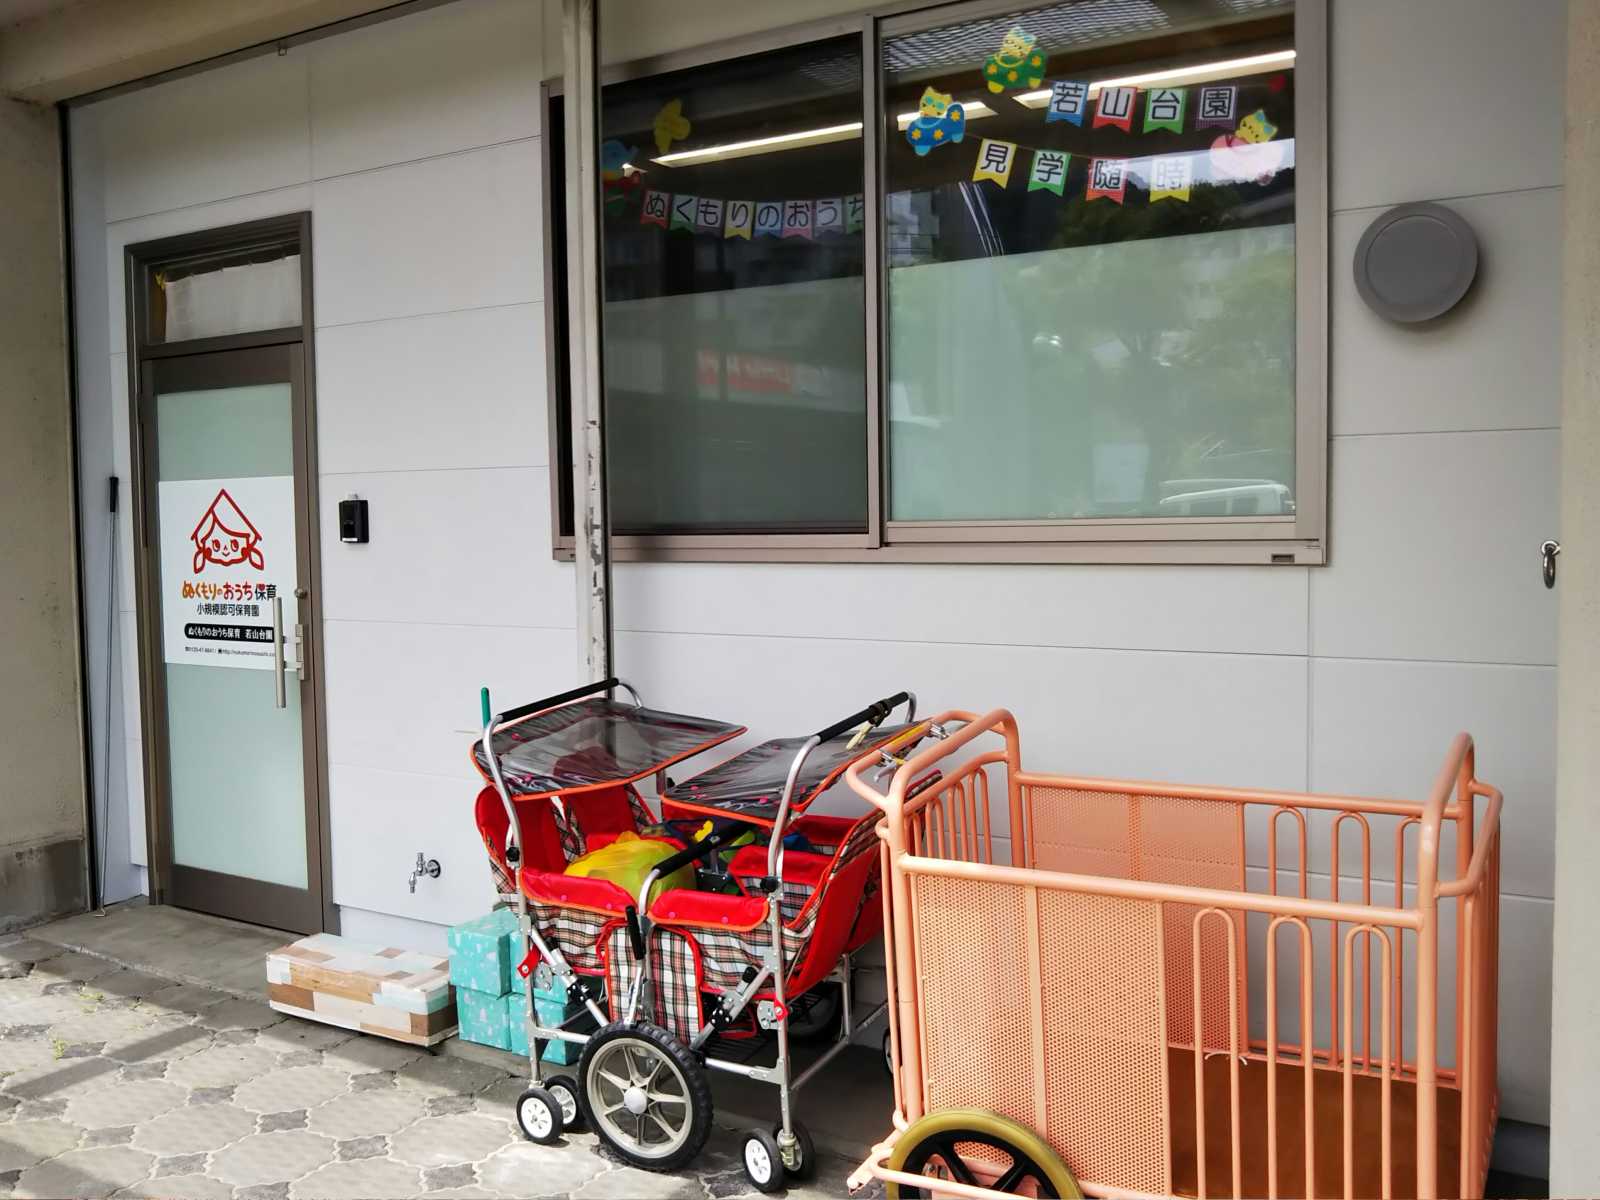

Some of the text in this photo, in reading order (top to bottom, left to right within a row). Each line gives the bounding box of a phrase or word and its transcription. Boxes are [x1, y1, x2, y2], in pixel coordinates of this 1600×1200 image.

[1055, 83, 1232, 120] 若山台園
[980, 143, 1185, 190] 見学随時
[197, 603, 260, 617] 小規模認可保育園
